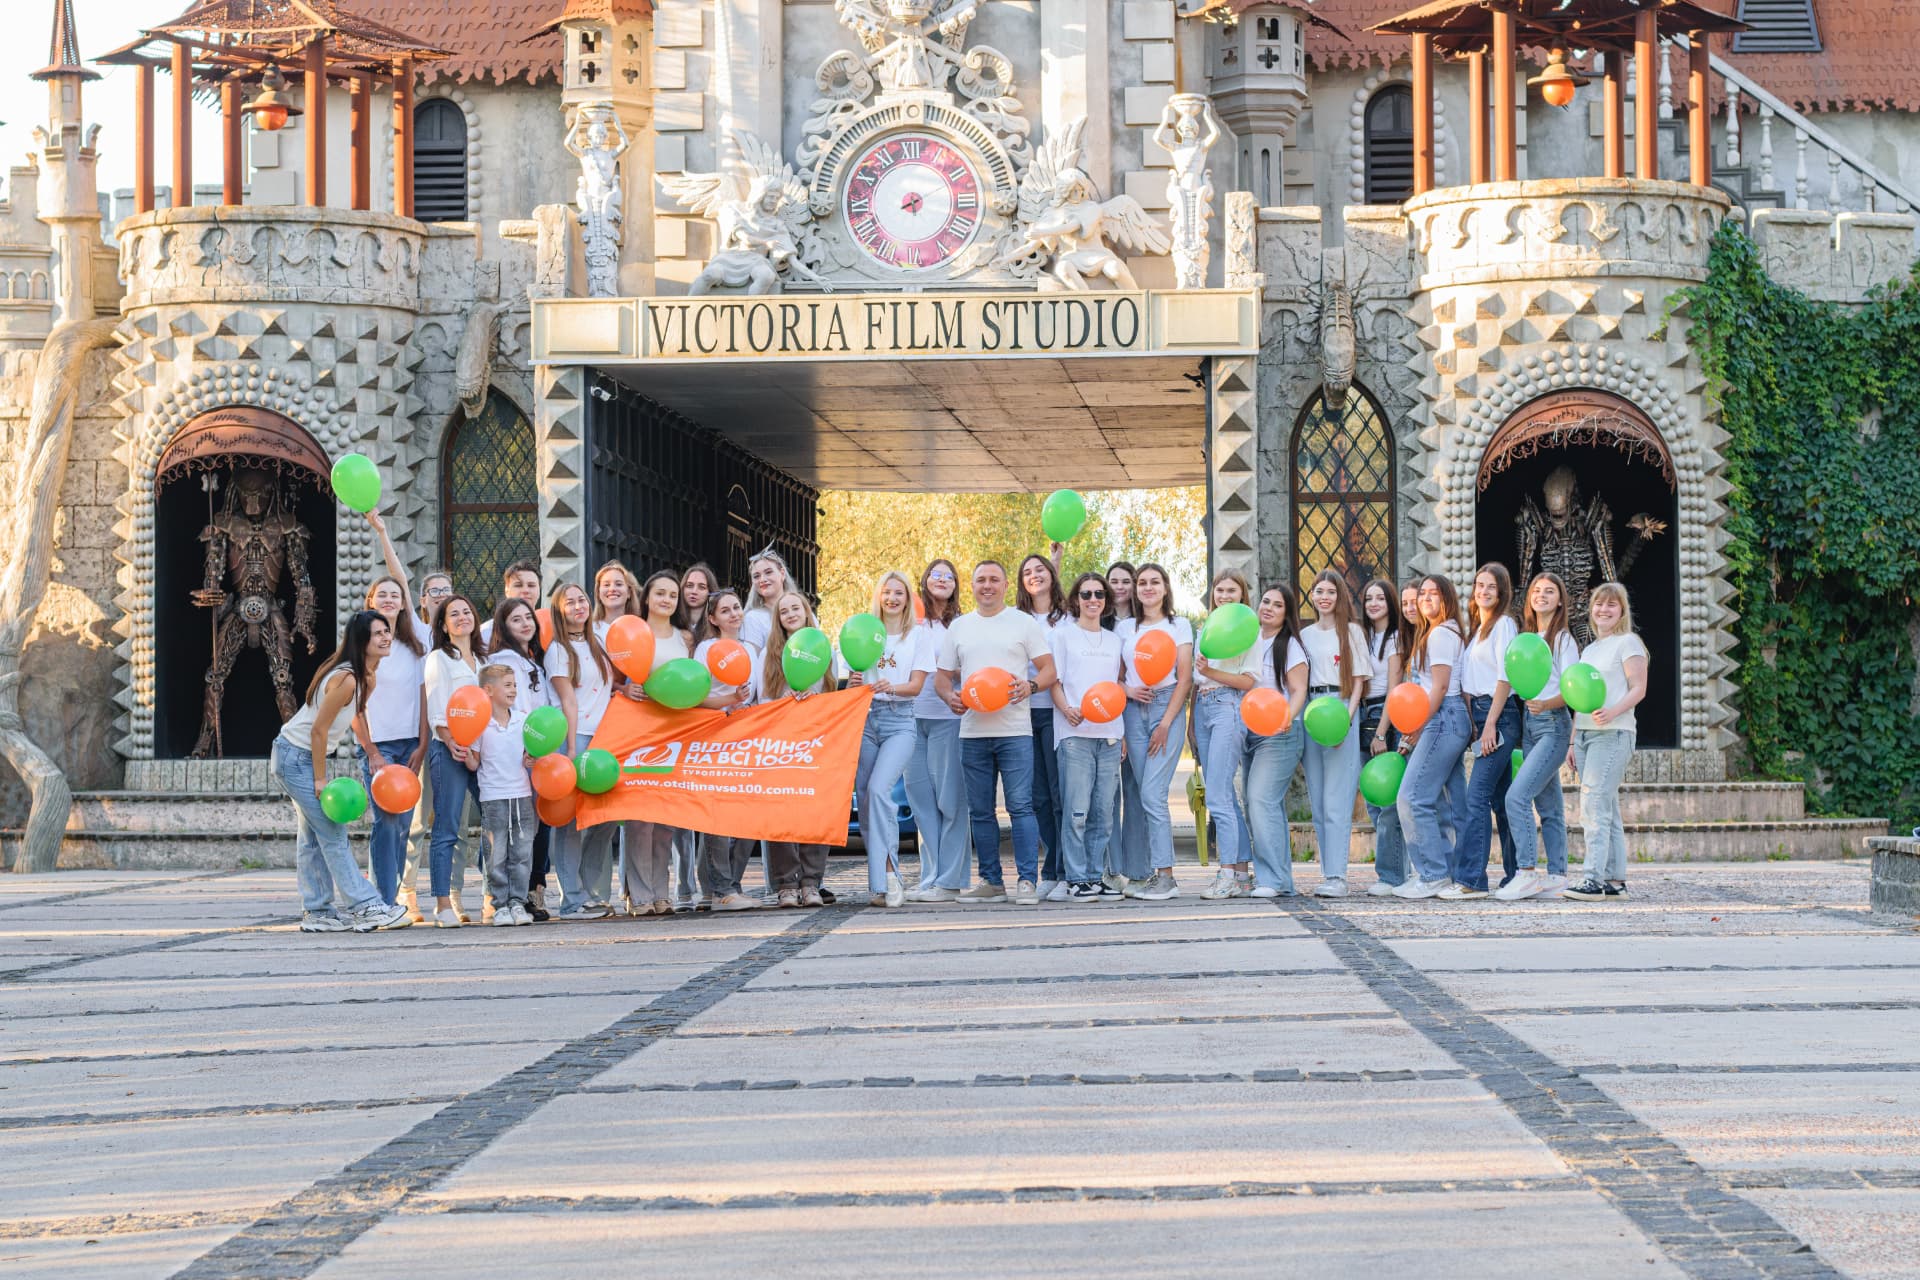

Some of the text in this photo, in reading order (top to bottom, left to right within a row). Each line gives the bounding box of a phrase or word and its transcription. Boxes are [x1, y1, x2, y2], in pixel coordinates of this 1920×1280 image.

[875, 148, 894, 169] XI
[901, 141, 921, 160] XII
[933, 148, 942, 164] I
[856, 172, 875, 186] X
[949, 166, 967, 182] II
[851, 198, 869, 212] IX
[957, 192, 976, 209] III
[907, 247, 923, 265] VI
[937, 240, 949, 256] V
[648, 298, 1139, 353] VICTORIA FILM STUDIO
[689, 735, 825, 753] ВІДПОЧИНОК
[684, 750, 814, 767] НА ВСІ 100%
[683, 769, 753, 777] ТУРОПЕРАТОР
[625, 779, 815, 796] www.otdihnavse100.com.ua
